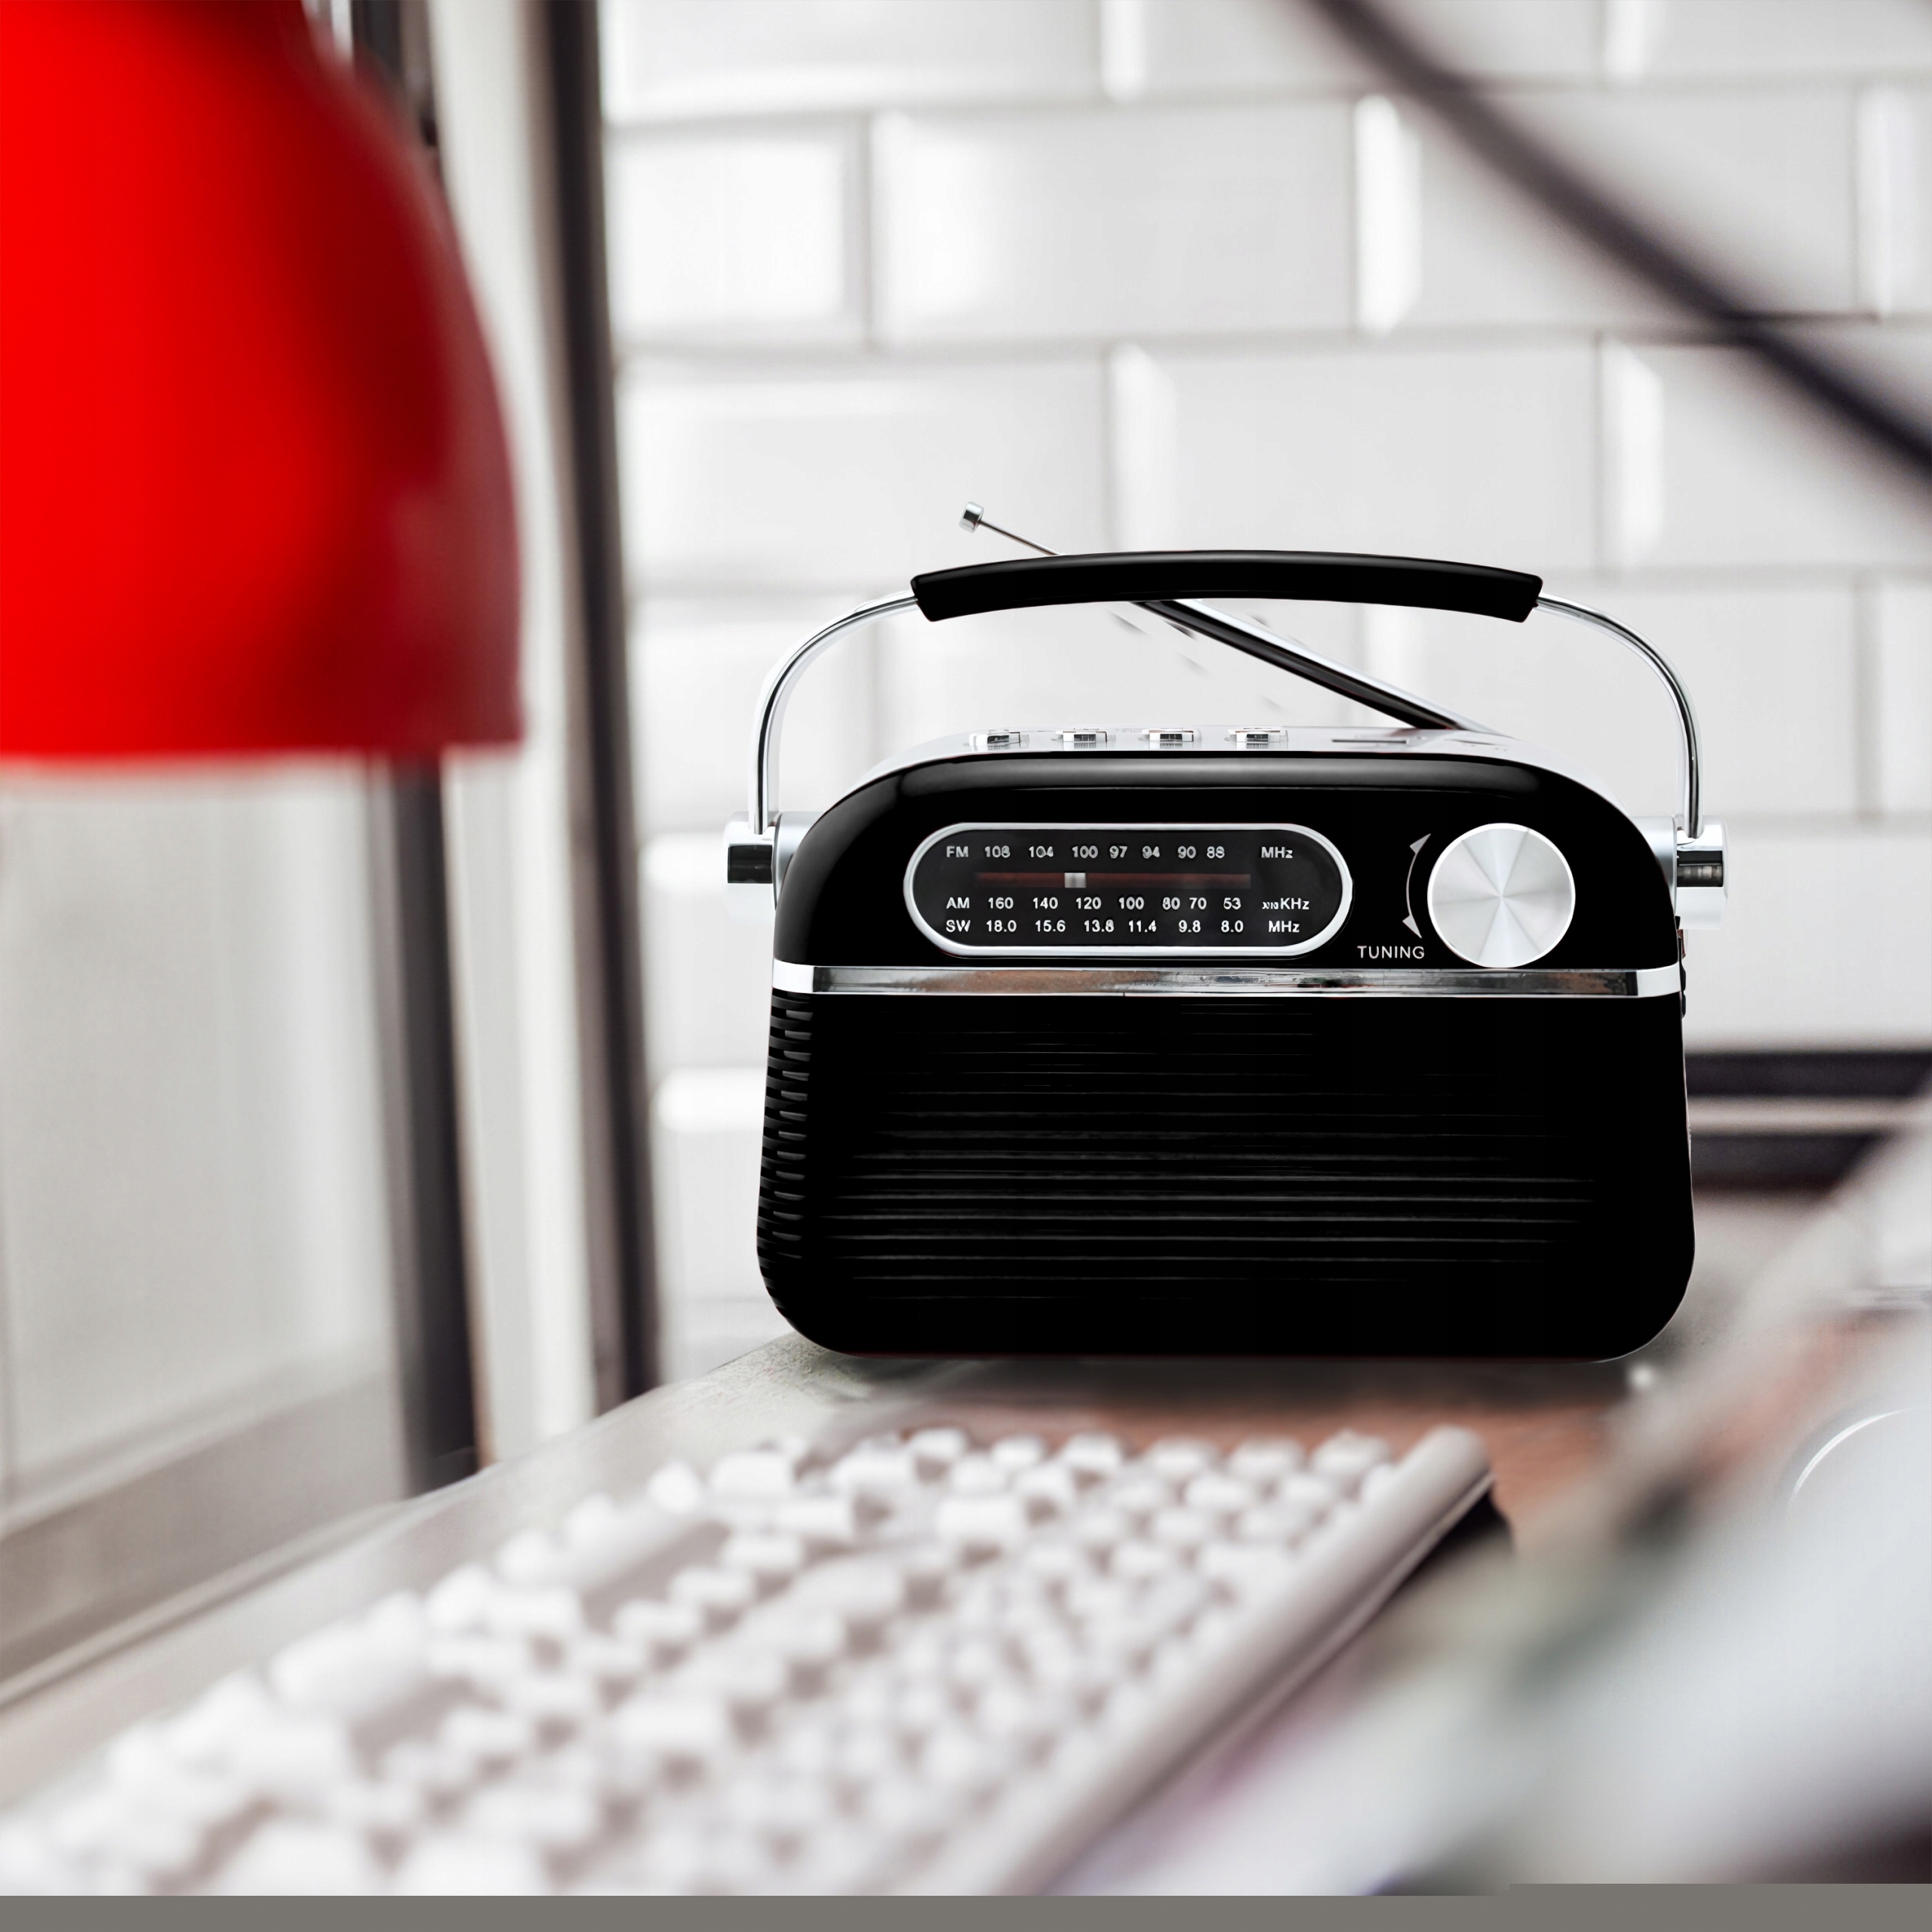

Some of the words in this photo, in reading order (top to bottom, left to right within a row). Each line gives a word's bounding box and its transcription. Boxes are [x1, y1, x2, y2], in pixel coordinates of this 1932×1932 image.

[946, 845, 969, 858] FM
[984, 845, 1011, 859] 108
[1029, 845, 1054, 859] 104
[1072, 845, 1099, 859] 100
[1109, 845, 1128, 859] 97
[1142, 845, 1161, 859] 94
[1177, 845, 1197, 859] 90
[1206, 845, 1226, 859] 88
[1261, 846, 1294, 859] MHz
[946, 897, 970, 909] AM
[988, 897, 1014, 910] 160
[1032, 897, 1059, 909] 140
[1075, 897, 1102, 910] 120
[1118, 897, 1145, 910] 100
[1161, 897, 1181, 910] 80
[1189, 897, 1208, 910] 70
[1223, 897, 1241, 910] 53
[946, 919, 971, 932] SW
[986, 919, 1017, 933] 18.0
[1035, 919, 1066, 933] 15.6
[1084, 919, 1115, 933] 13.8
[1128, 919, 1157, 933] 11.4
[1178, 919, 1201, 933] 9.8
[1220, 919, 1244, 933] 8.0
[1268, 920, 1300, 933] MHz
[1357, 945, 1425, 959] TUNING
